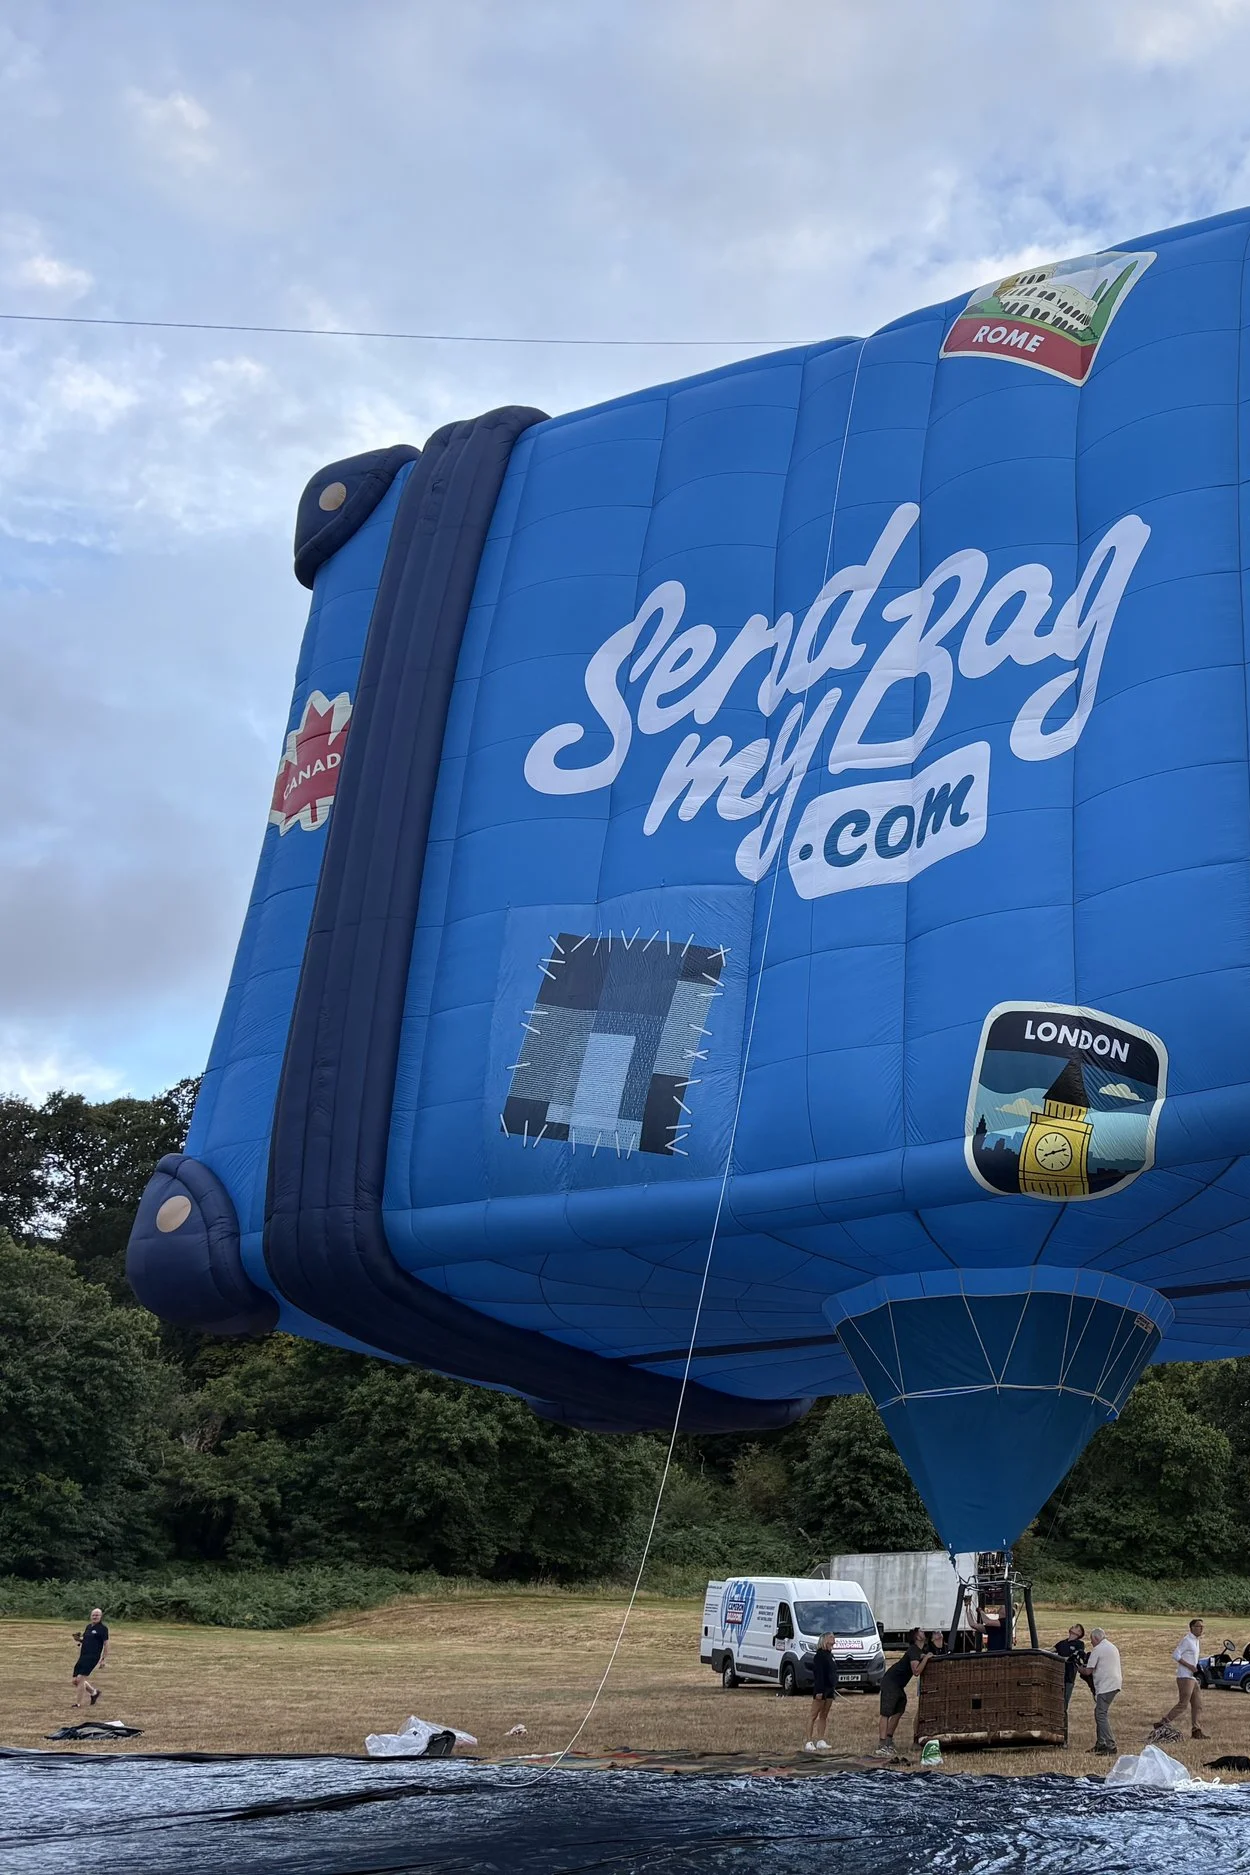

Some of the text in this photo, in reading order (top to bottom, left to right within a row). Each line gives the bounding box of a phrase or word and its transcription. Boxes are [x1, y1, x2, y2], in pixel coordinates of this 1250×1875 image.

[971, 325, 1046, 353] ROME
[523, 501, 1152, 882] Send my Bag
[283, 752, 342, 801] CANAD
[799, 774, 975, 867] .com
[1024, 1019, 1130, 1063] LONDON
